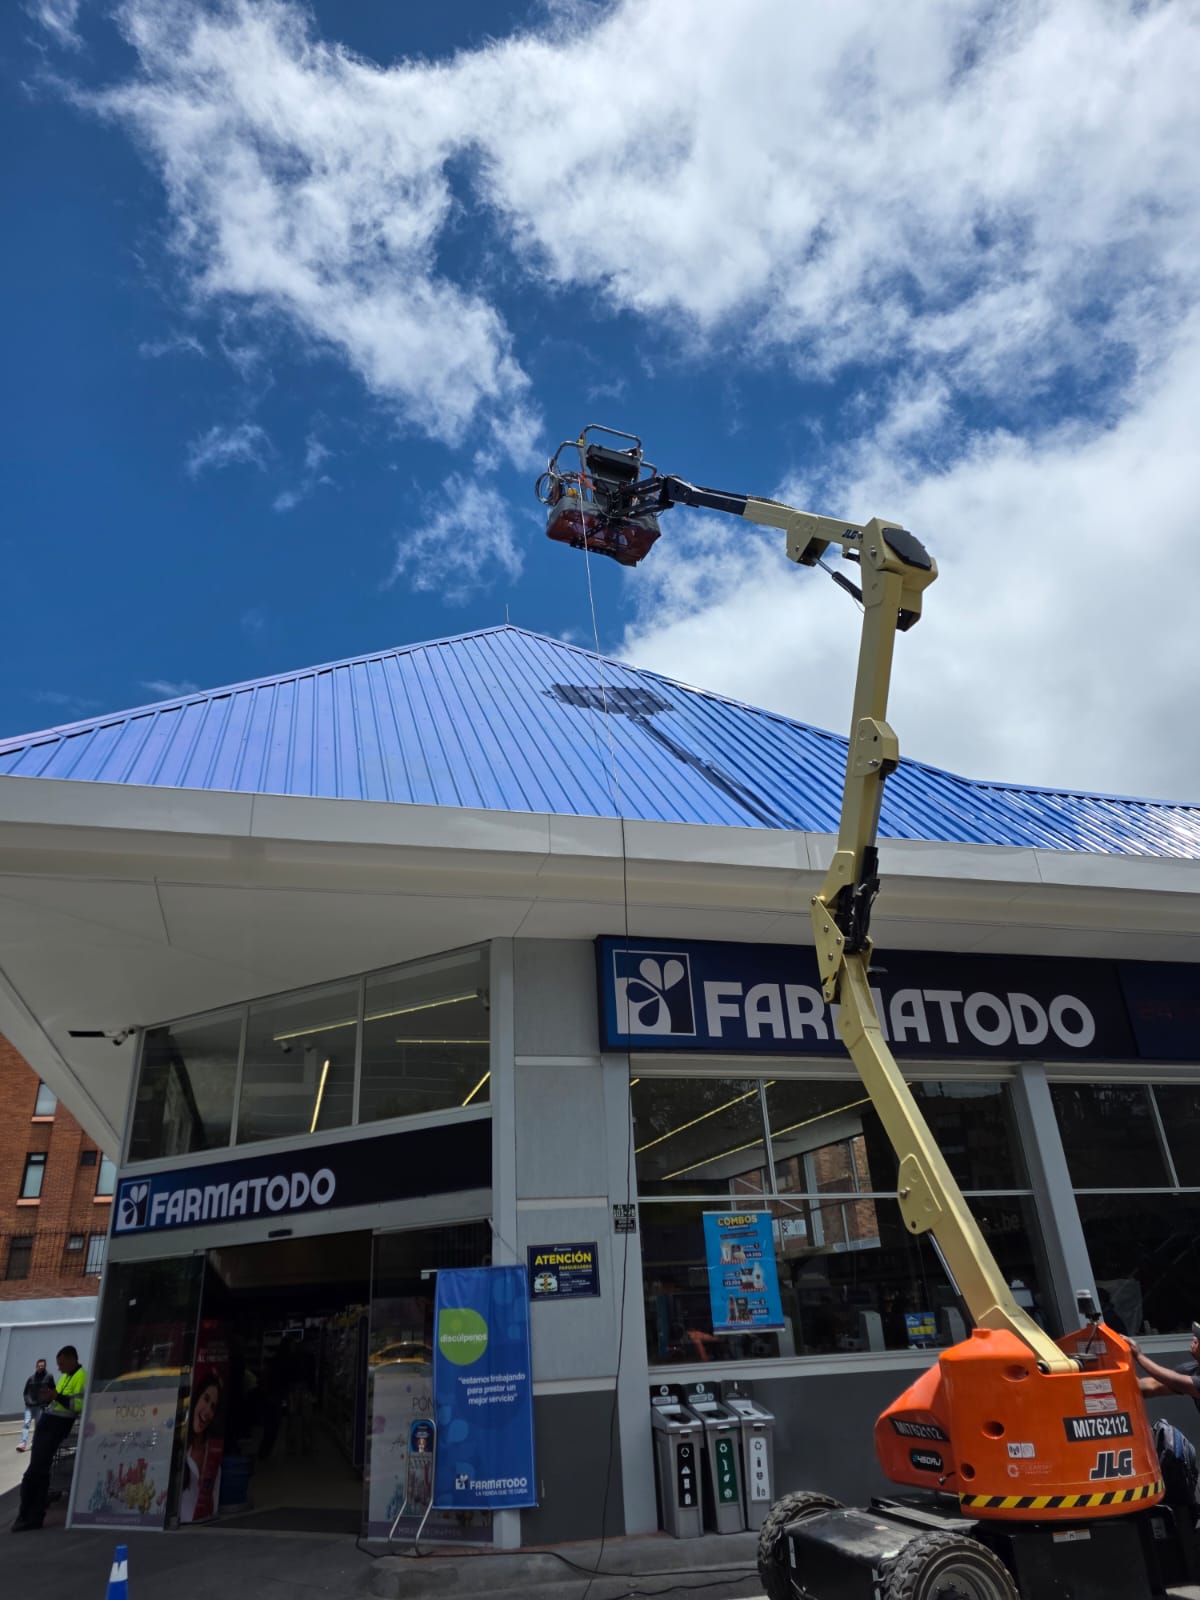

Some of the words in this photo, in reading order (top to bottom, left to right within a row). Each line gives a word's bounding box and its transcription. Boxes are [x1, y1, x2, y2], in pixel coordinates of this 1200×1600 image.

[150, 1168, 336, 1226] FARMATODO
[718, 1215, 758, 1226] COMBOS
[535, 1251, 592, 1265] ATENCIÓN
[490, 1373, 525, 1382] trabajando
[467, 1387, 483, 1395] para
[484, 1384, 505, 1394] prestar
[468, 1397, 488, 1406] mejor
[1072, 1415, 1129, 1438] MI762112
[1090, 1448, 1133, 1480] JLG
[470, 1478, 527, 1490] FARMATODO
